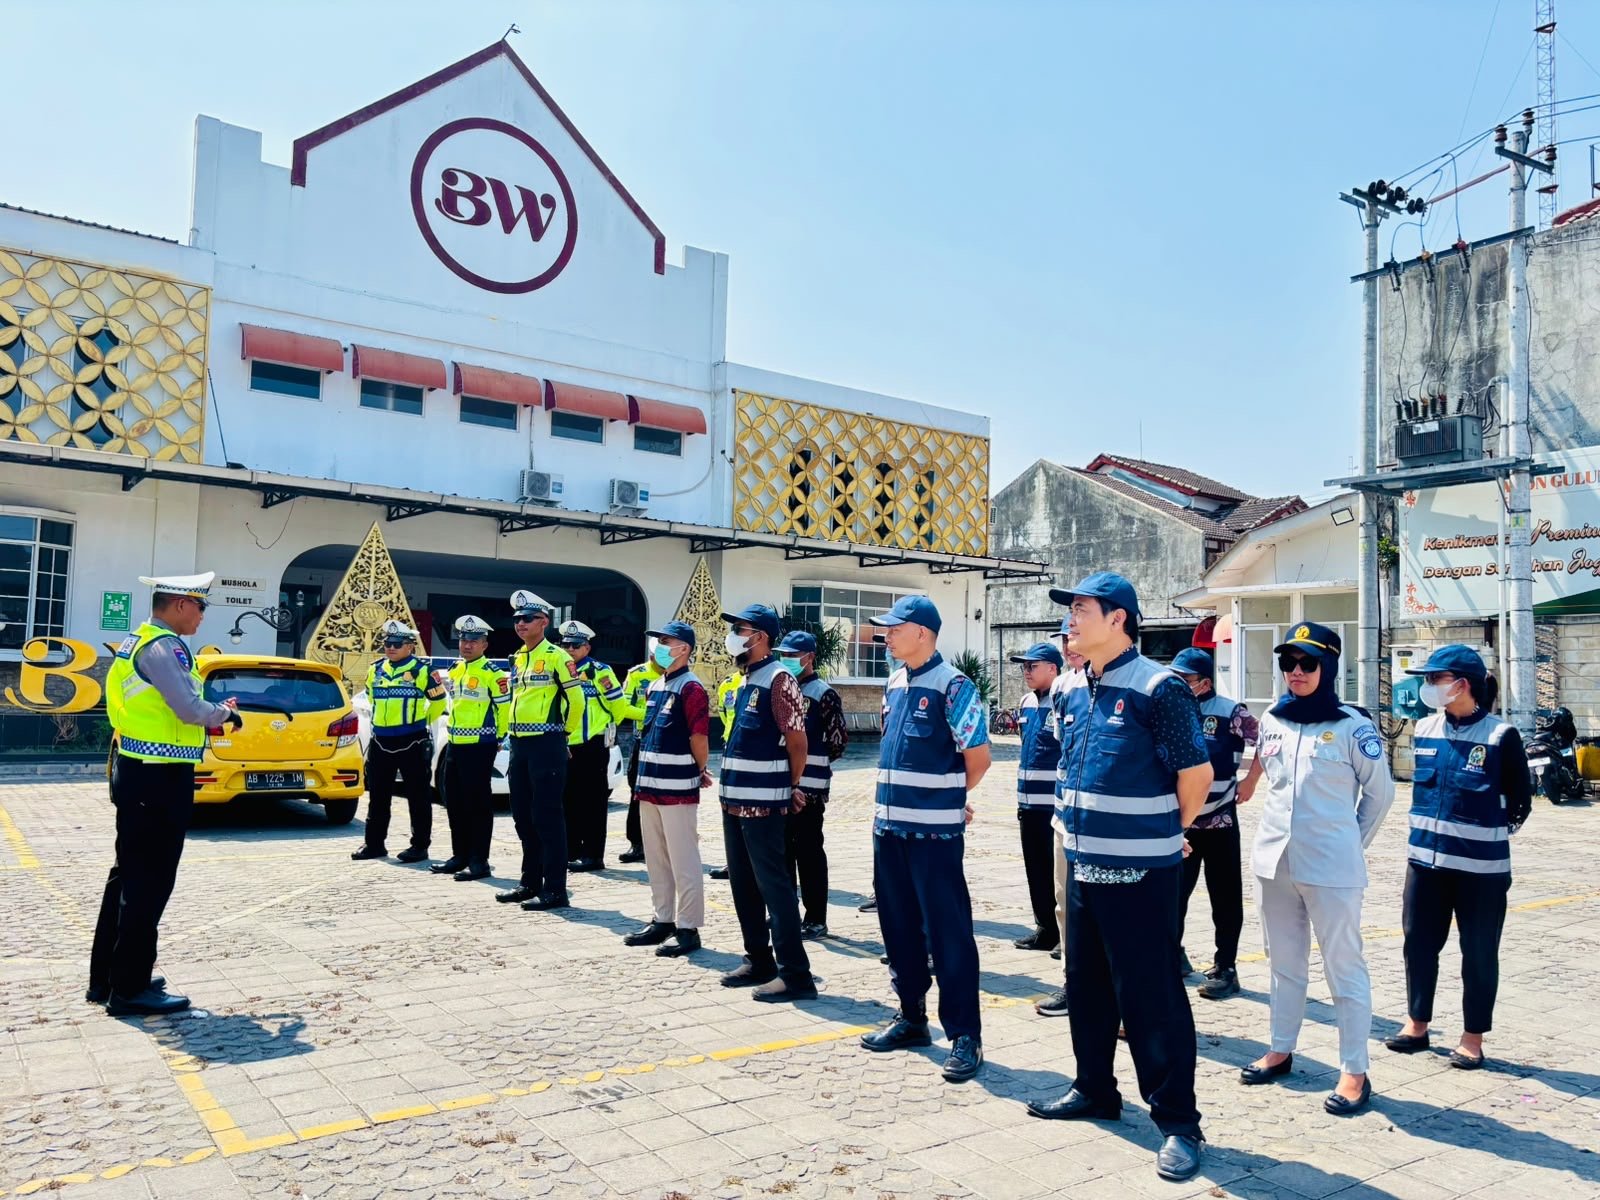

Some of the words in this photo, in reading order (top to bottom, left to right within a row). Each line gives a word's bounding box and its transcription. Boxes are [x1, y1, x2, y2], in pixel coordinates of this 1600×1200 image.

[434, 167, 557, 242] BW
[1550, 469, 1600, 489] GULU
[1422, 565, 1482, 580] Dengan
[221, 579, 258, 588] MUSHOLA
[225, 596, 253, 605] TOILET
[248, 773, 258, 784] AB
[265, 773, 285, 783] 1225
